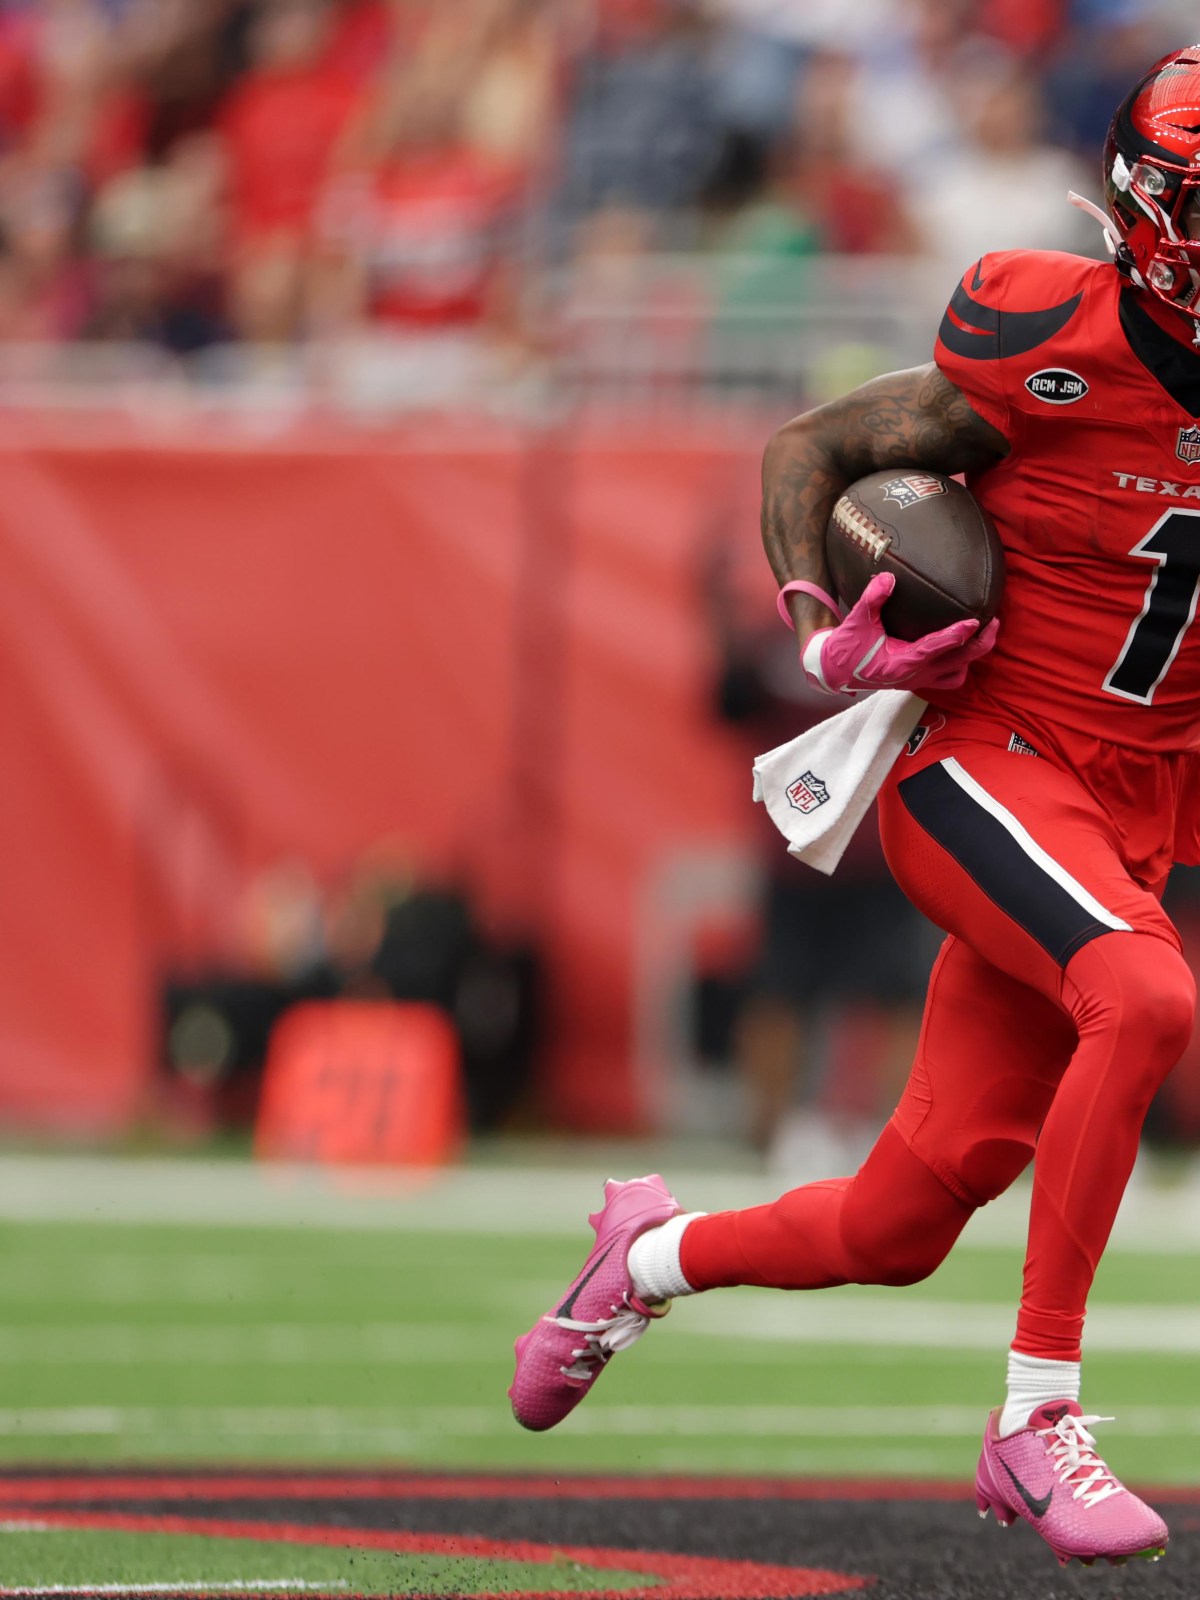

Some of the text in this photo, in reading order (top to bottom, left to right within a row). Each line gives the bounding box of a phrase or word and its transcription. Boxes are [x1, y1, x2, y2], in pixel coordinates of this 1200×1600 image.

[1031, 378, 1083, 395] RCM JSM
[906, 474, 942, 498] NFL
[789, 782, 816, 811] NFL
